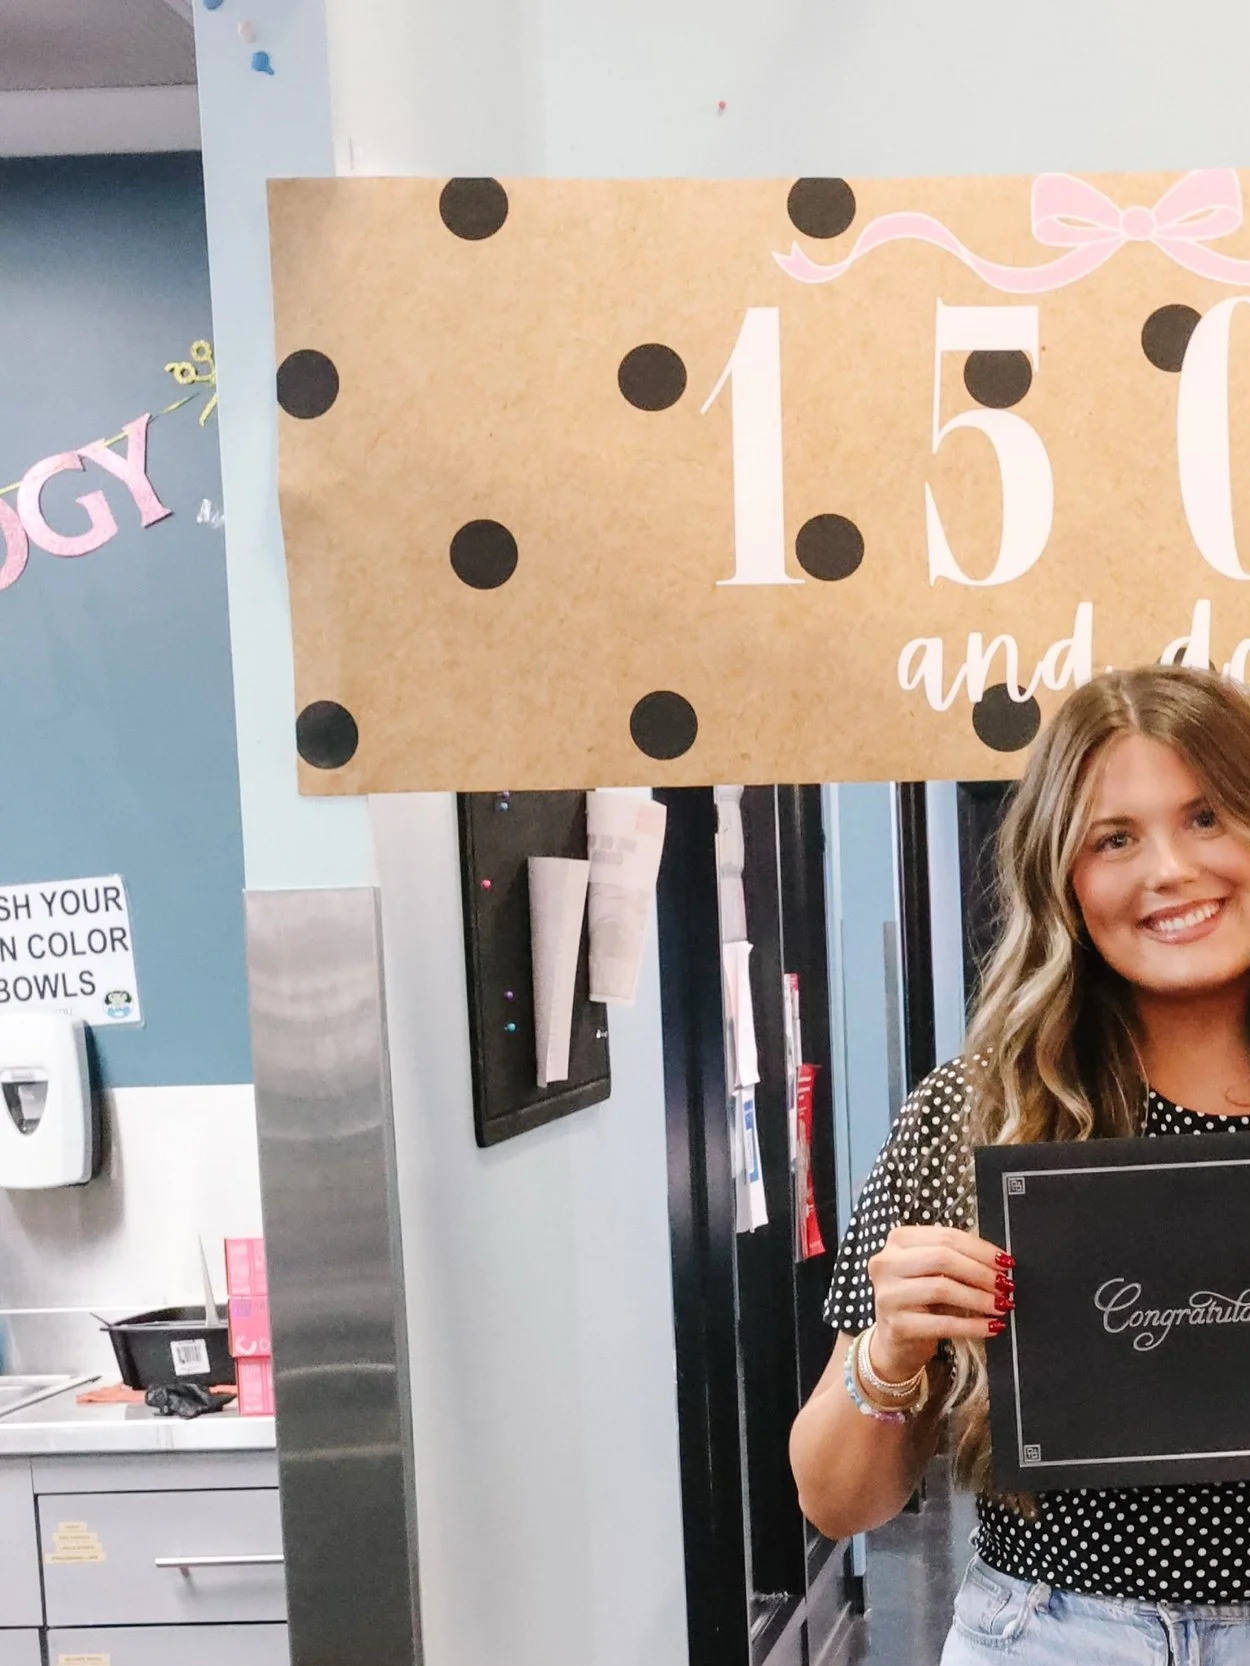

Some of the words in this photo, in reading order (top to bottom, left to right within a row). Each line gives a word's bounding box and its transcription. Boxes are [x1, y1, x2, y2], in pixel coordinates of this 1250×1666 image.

[897, 601, 1094, 711] and
[40, 886, 123, 917] YOUR
[27, 927, 129, 960] COLOR
[0, 970, 96, 1003] BOWLS
